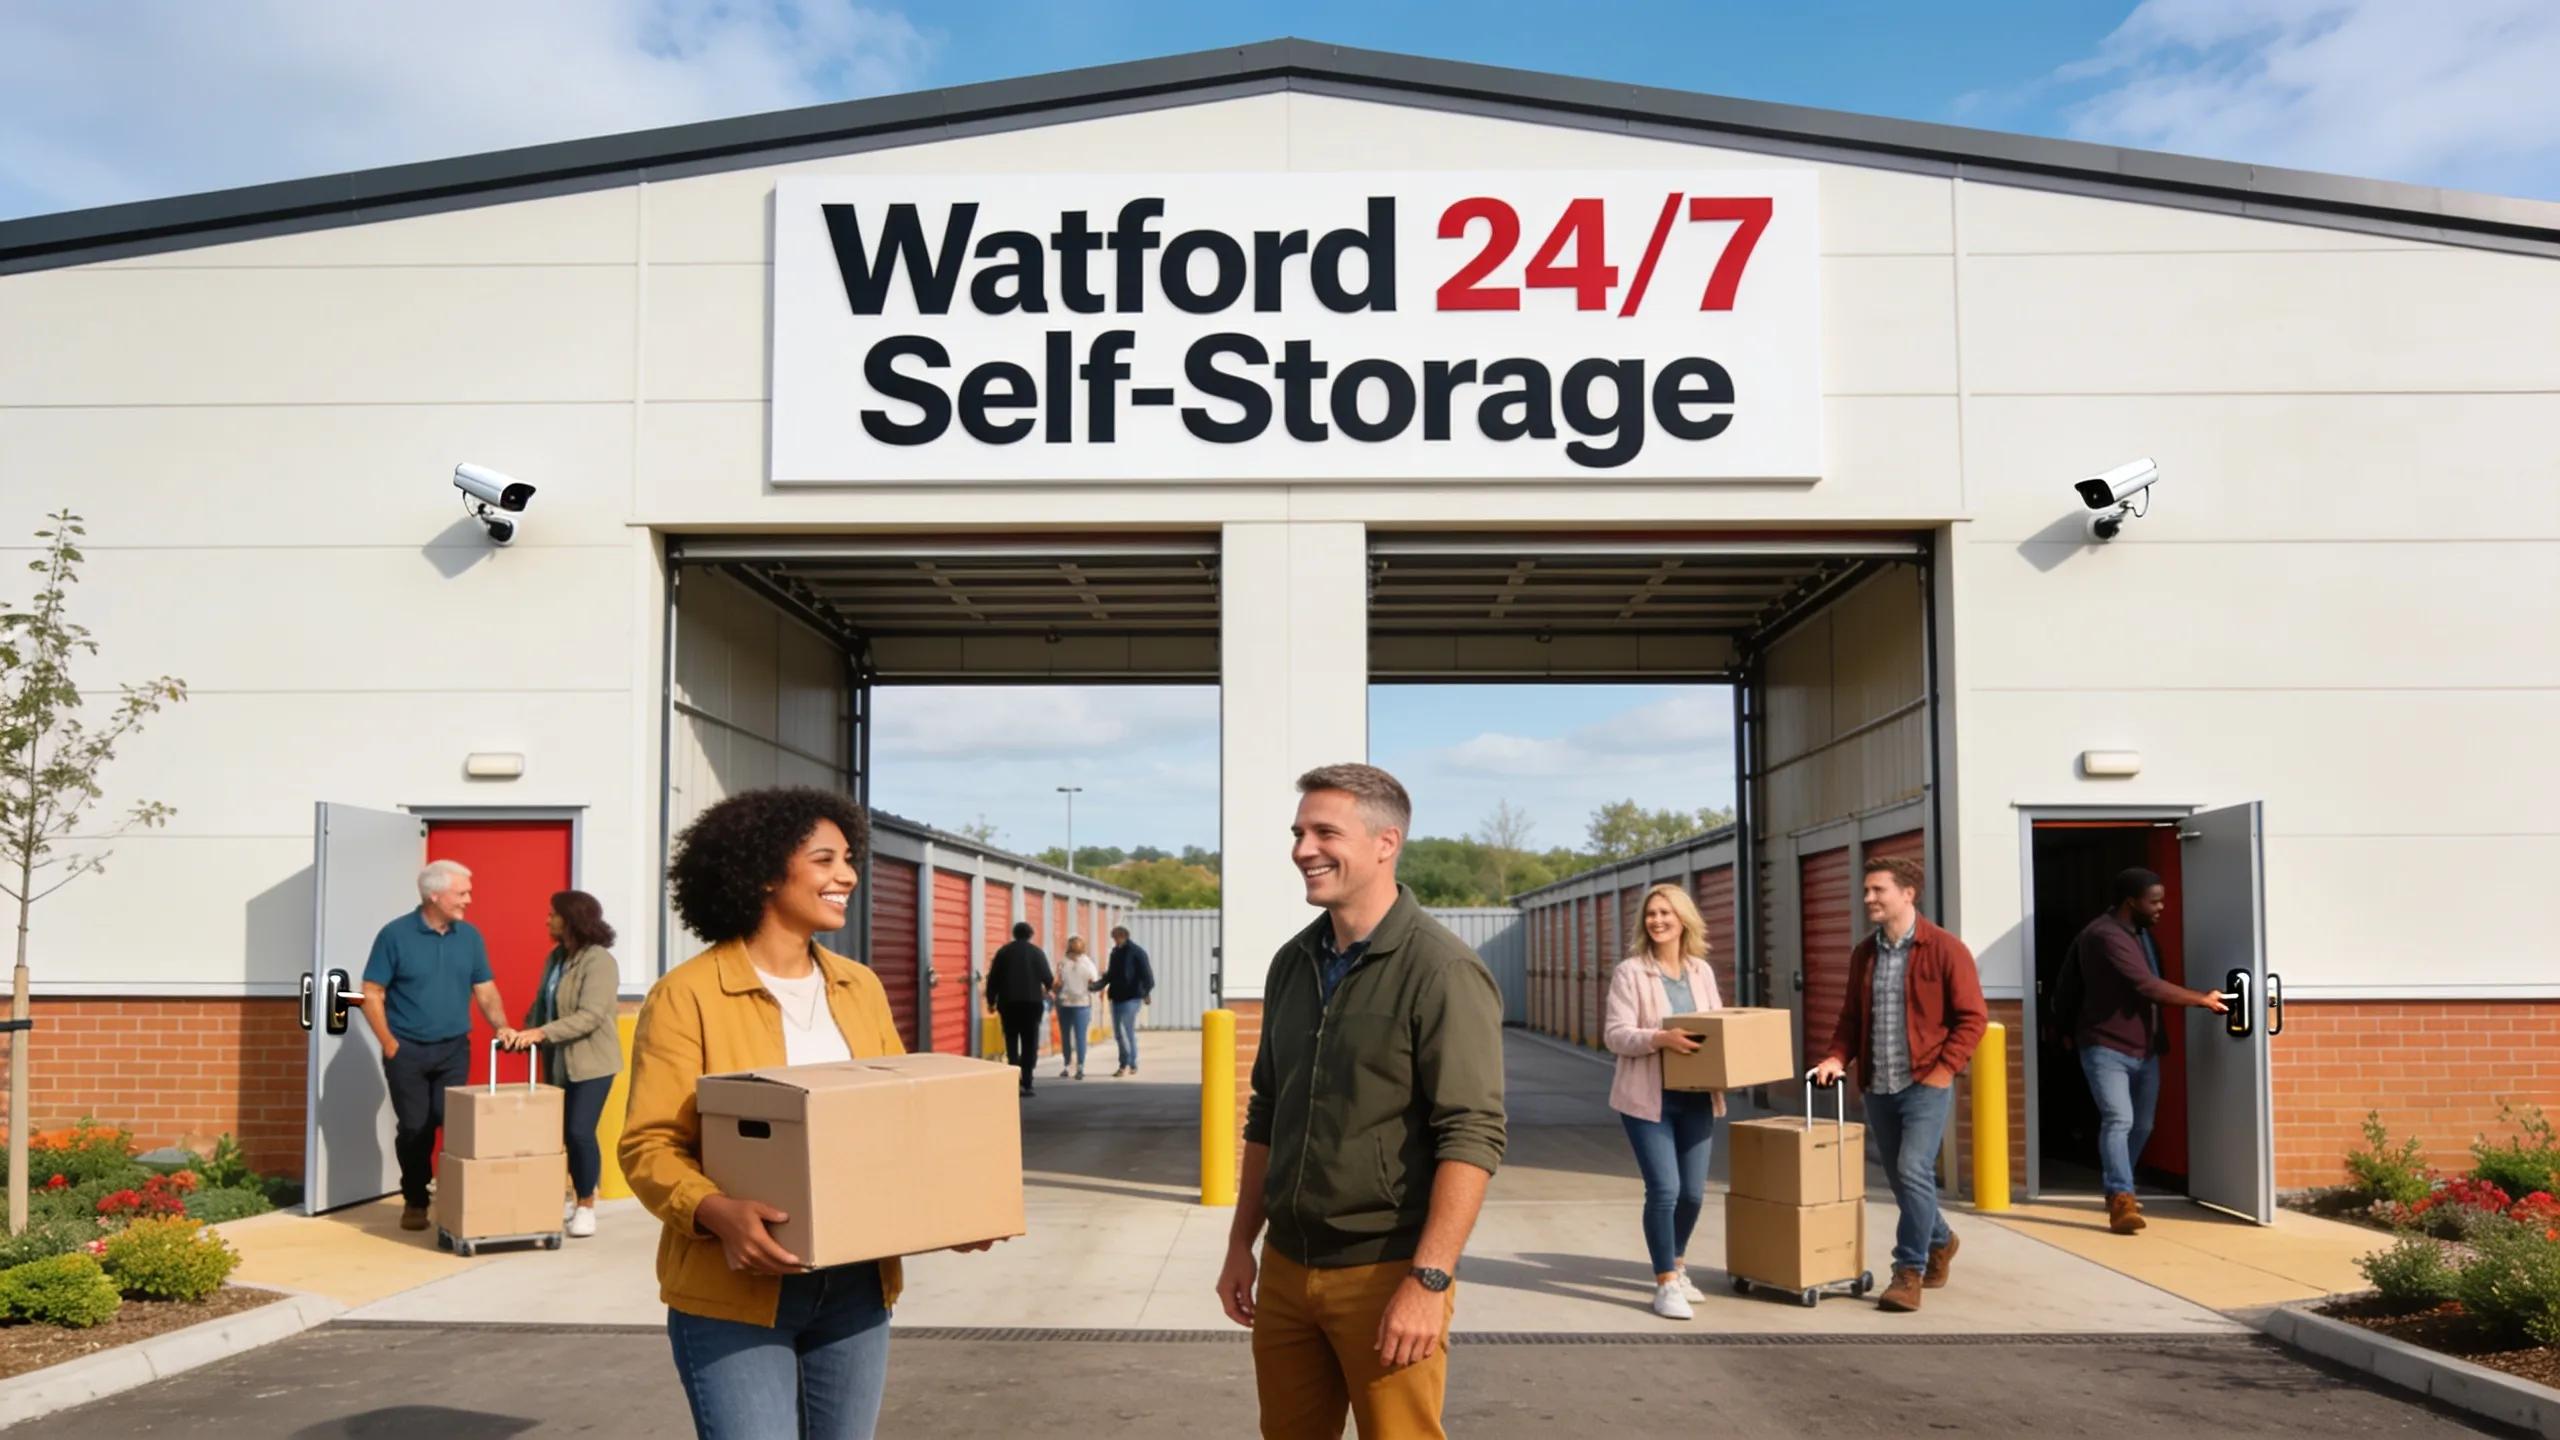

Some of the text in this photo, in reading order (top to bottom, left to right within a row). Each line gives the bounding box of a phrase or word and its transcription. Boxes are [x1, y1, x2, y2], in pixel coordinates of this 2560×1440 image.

[821, 192, 1774, 318] Watford 24/7
[860, 329, 1735, 469] Self-Storage
